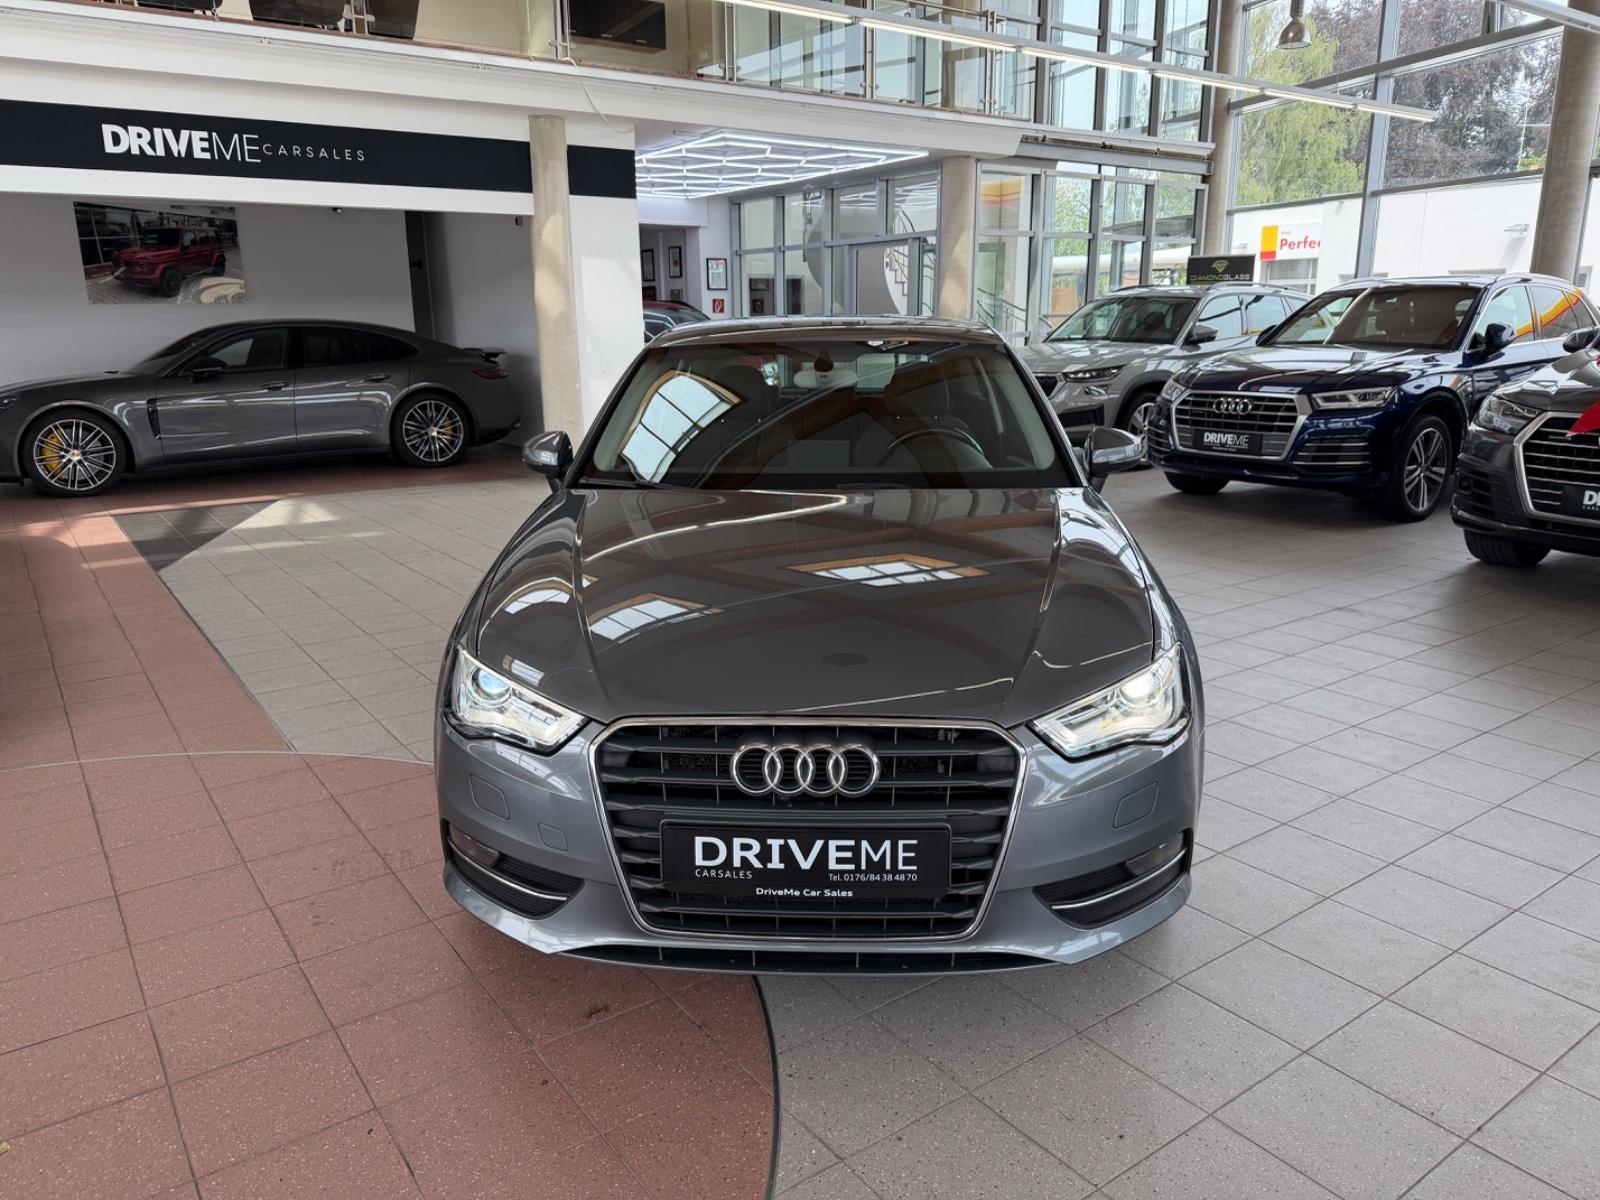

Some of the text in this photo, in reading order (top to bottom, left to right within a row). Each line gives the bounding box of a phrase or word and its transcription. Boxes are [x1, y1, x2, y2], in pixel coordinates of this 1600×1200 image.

[101, 123, 366, 163] DRIVEME CARSALES
[1203, 431, 1250, 447] DRIVEME
[1583, 490, 1600, 505] D
[694, 836, 918, 871] DRIVEME
[695, 868, 753, 880] CARSALES
[755, 887, 854, 898] DriveMe Car Sales
